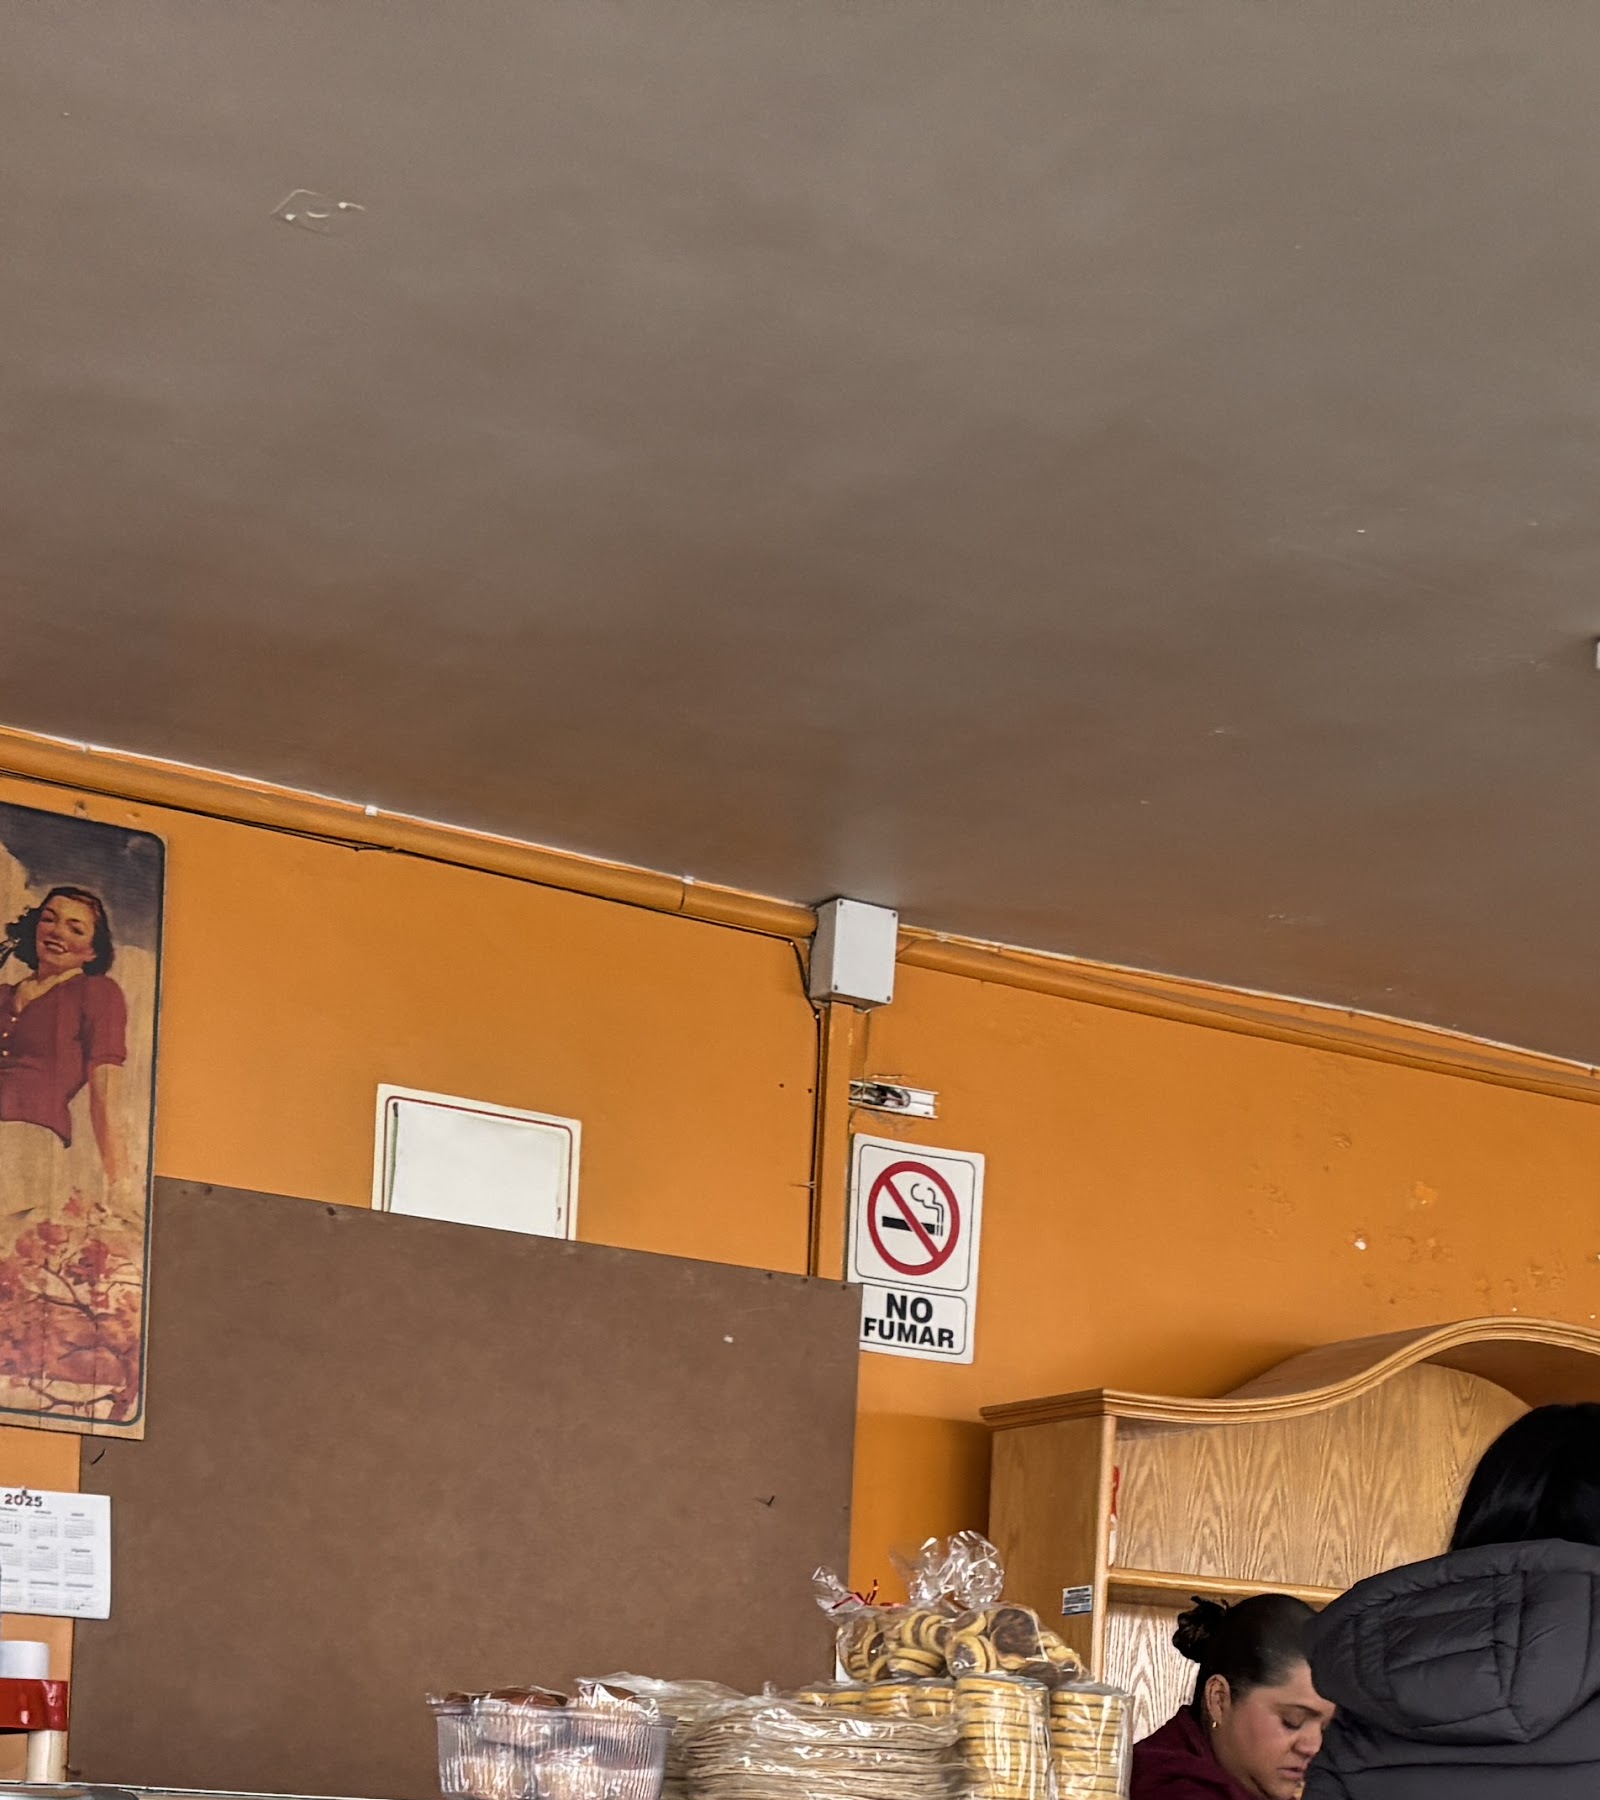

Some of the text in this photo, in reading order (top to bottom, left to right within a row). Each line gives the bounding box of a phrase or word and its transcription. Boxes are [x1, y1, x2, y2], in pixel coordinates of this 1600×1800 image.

[886, 1292, 933, 1324] NO
[864, 1317, 954, 1348] FUMAR
[4, 1493, 43, 1508] 2025
